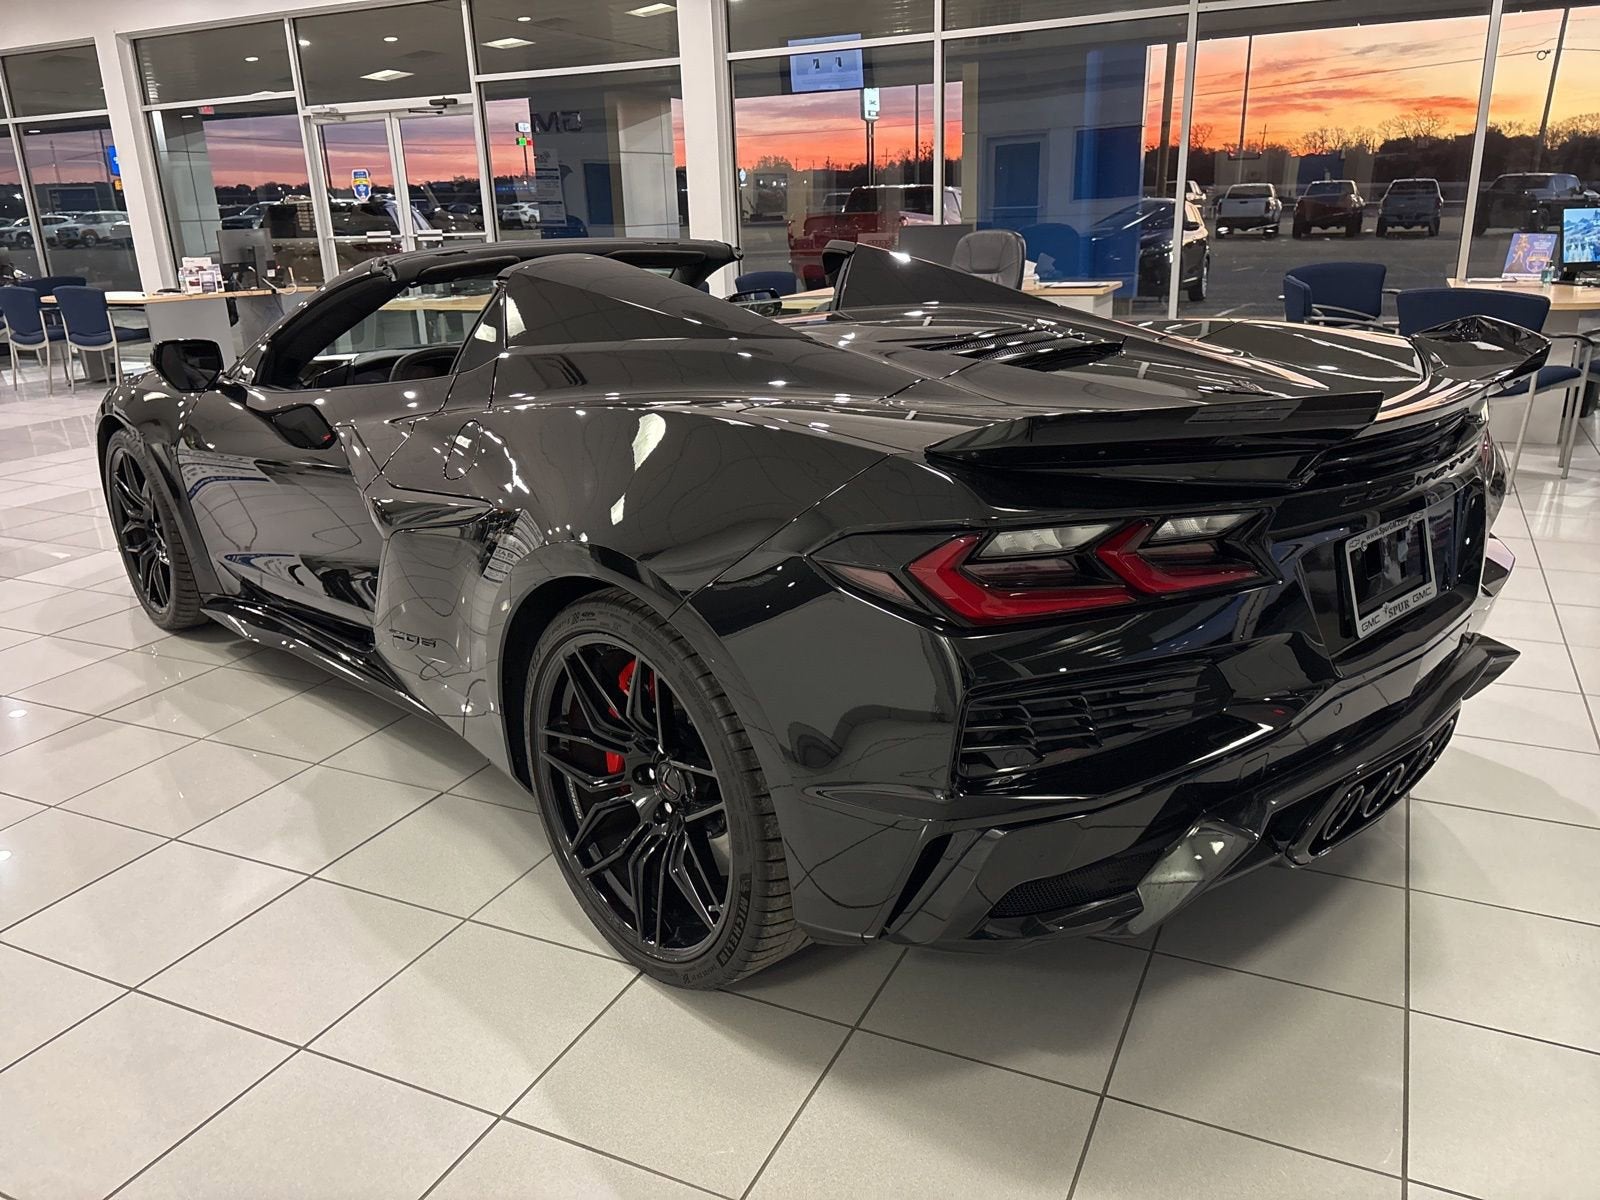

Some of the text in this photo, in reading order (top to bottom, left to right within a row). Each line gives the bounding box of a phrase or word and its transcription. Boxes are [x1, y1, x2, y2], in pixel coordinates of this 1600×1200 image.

[1361, 586, 1432, 632] GMC SPUR GMC
[718, 894, 750, 966] MICHELIN
